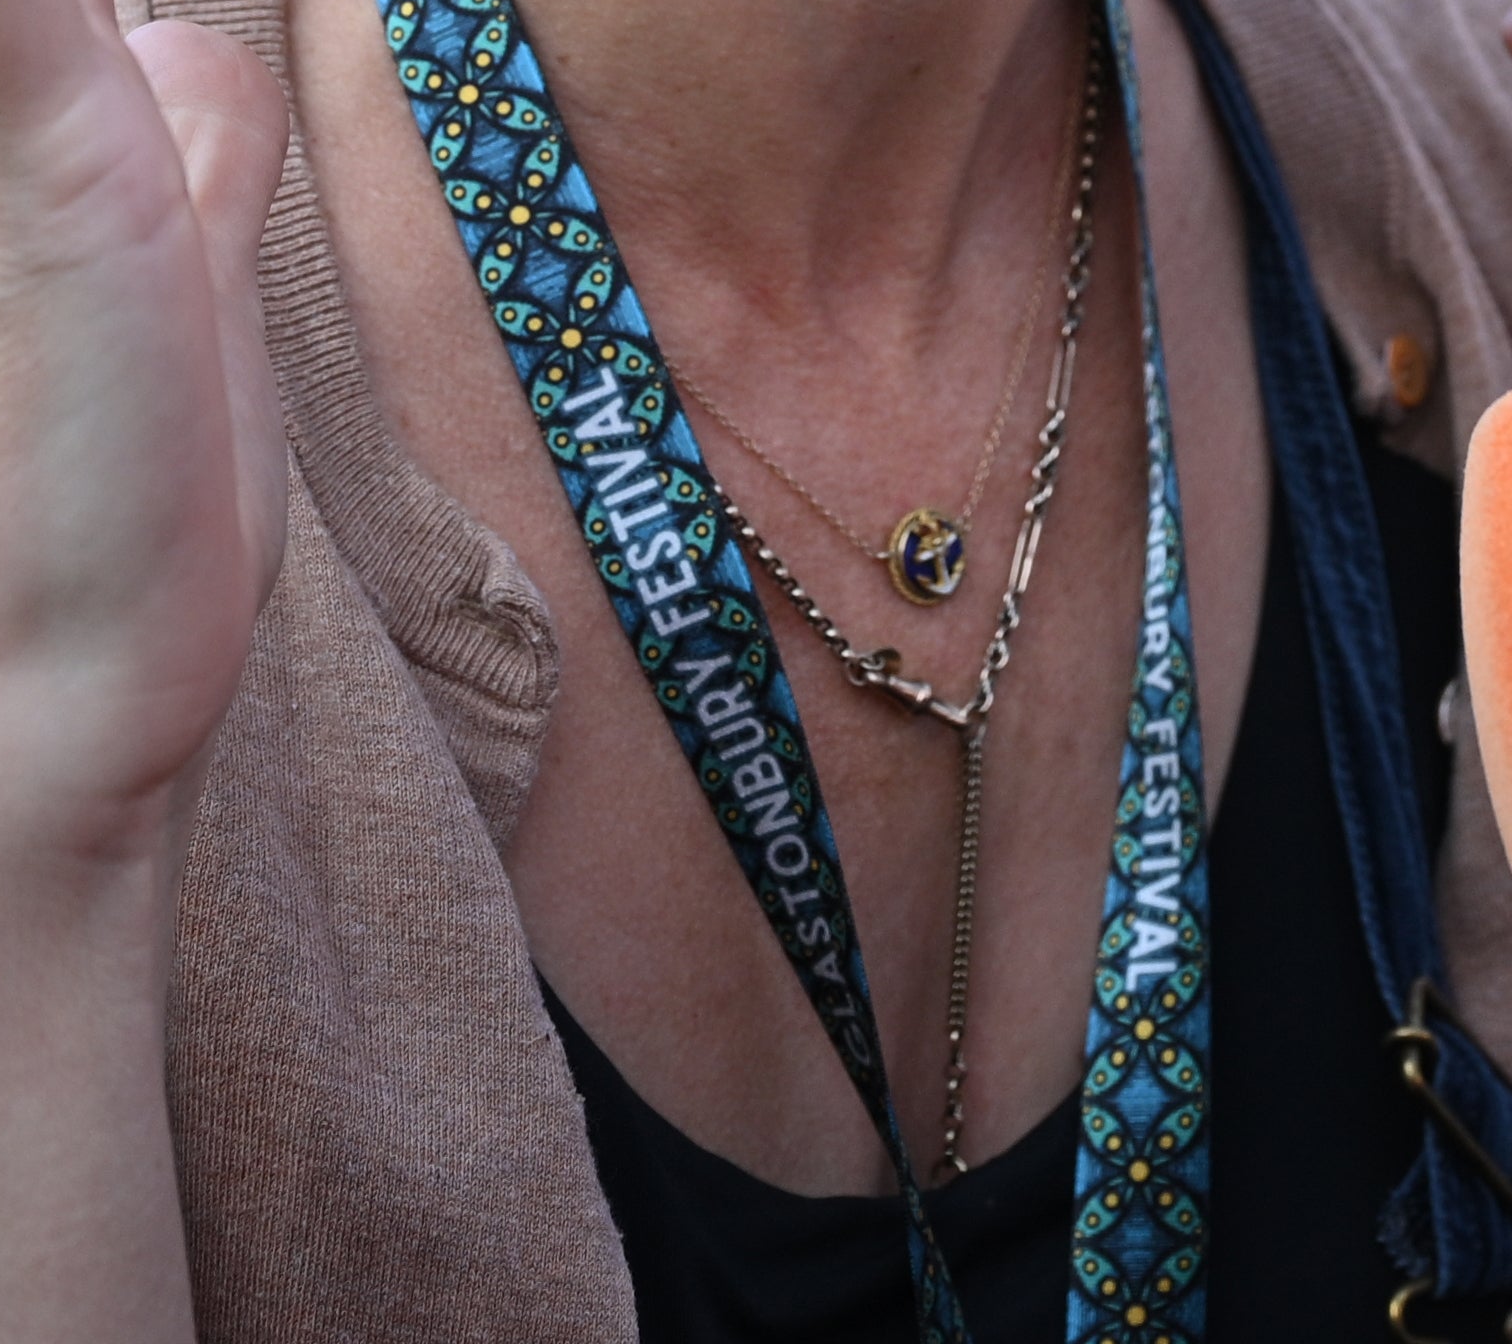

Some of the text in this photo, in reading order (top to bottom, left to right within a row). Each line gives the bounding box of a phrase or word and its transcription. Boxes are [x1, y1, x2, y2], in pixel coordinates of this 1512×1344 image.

[562, 366, 871, 1067] GLASTONBURY FESTIVAL
[1124, 322, 1182, 992] STONBURY FESTIVAL
